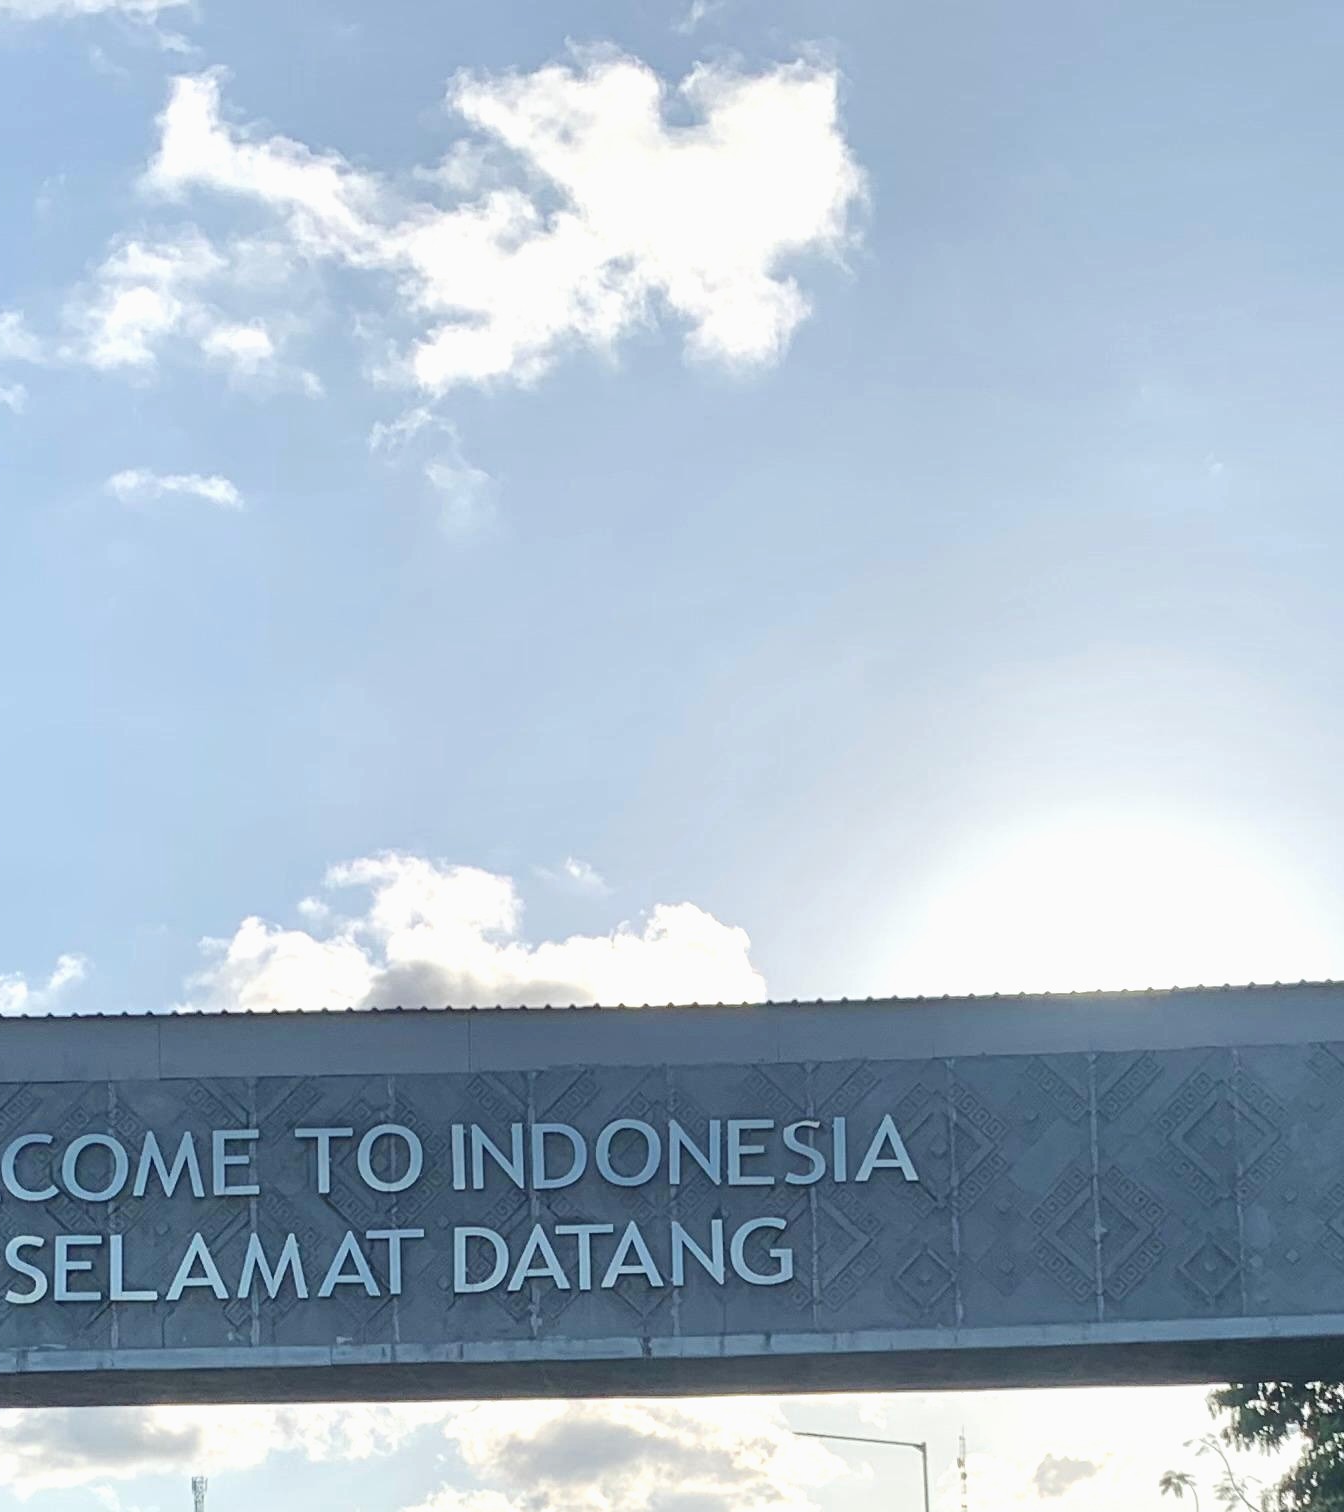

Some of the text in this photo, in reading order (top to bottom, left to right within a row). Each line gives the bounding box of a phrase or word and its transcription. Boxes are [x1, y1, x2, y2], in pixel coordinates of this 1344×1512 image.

[294, 1123, 424, 1194] TO
[452, 1113, 920, 1190] INDONESIA
[4, 1217, 794, 1304] SELAMAT DATANG
